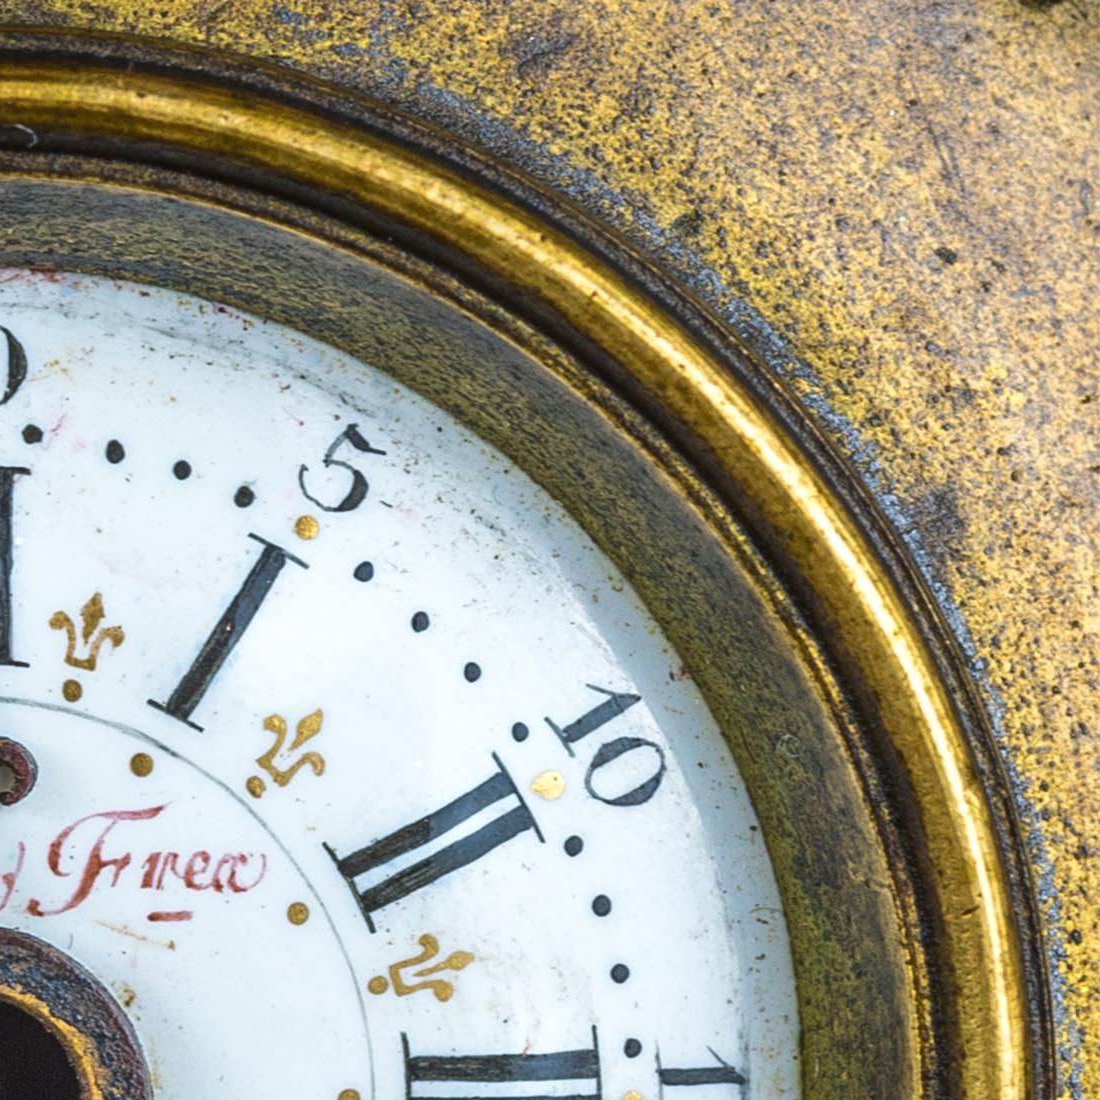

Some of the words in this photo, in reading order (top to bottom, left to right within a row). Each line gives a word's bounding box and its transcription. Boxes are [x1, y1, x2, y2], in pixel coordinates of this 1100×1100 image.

[299, 424, 386, 513] 5
[147, 533, 310, 732] I
[544, 683, 666, 807] 10
[322, 752, 545, 933] II
